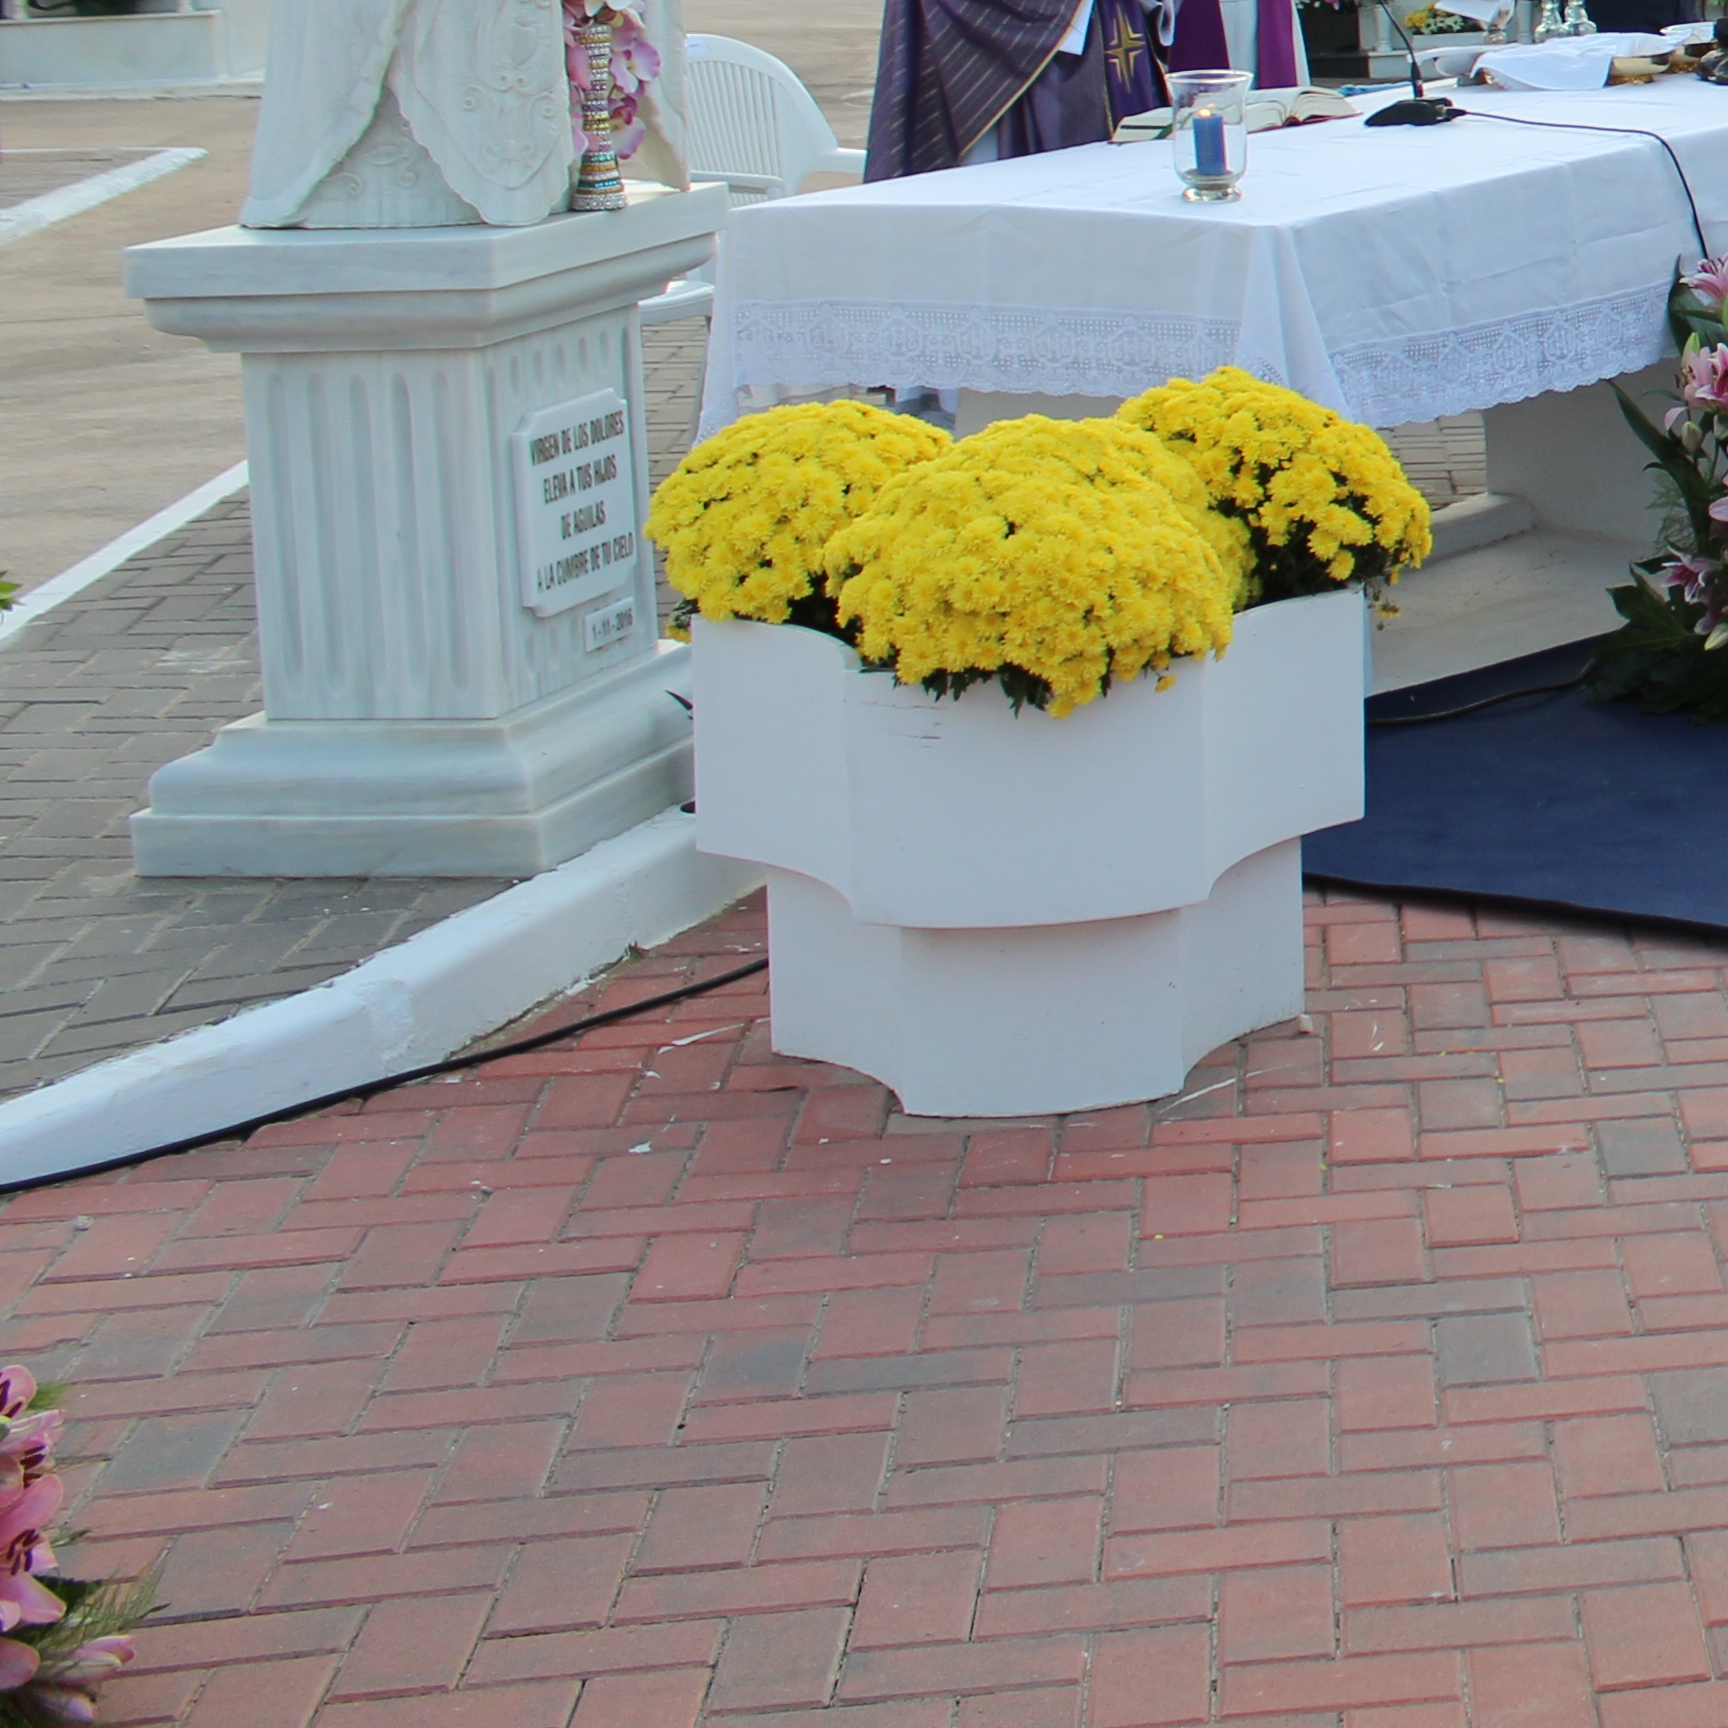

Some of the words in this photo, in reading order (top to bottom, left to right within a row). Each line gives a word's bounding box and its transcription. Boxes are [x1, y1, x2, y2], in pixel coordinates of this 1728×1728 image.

[530, 432, 560, 466] VIRGEN
[561, 428, 572, 454] DE
[574, 422, 589, 450] LOS
[590, 410, 624, 445] DOLORES
[543, 472, 569, 504] ELEVA
[569, 469, 576, 494] A
[576, 463, 593, 491] TUS
[593, 454, 617, 486] HIJOS
[561, 512, 572, 540] DE
[574, 500, 606, 535] AGUILAS
[537, 567, 545, 592] A
[545, 562, 556, 590] LA
[557, 549, 589, 585] CUMBRE
[590, 544, 601, 571] DE
[602, 540, 612, 565] TU
[613, 531, 634, 561] CIELO
